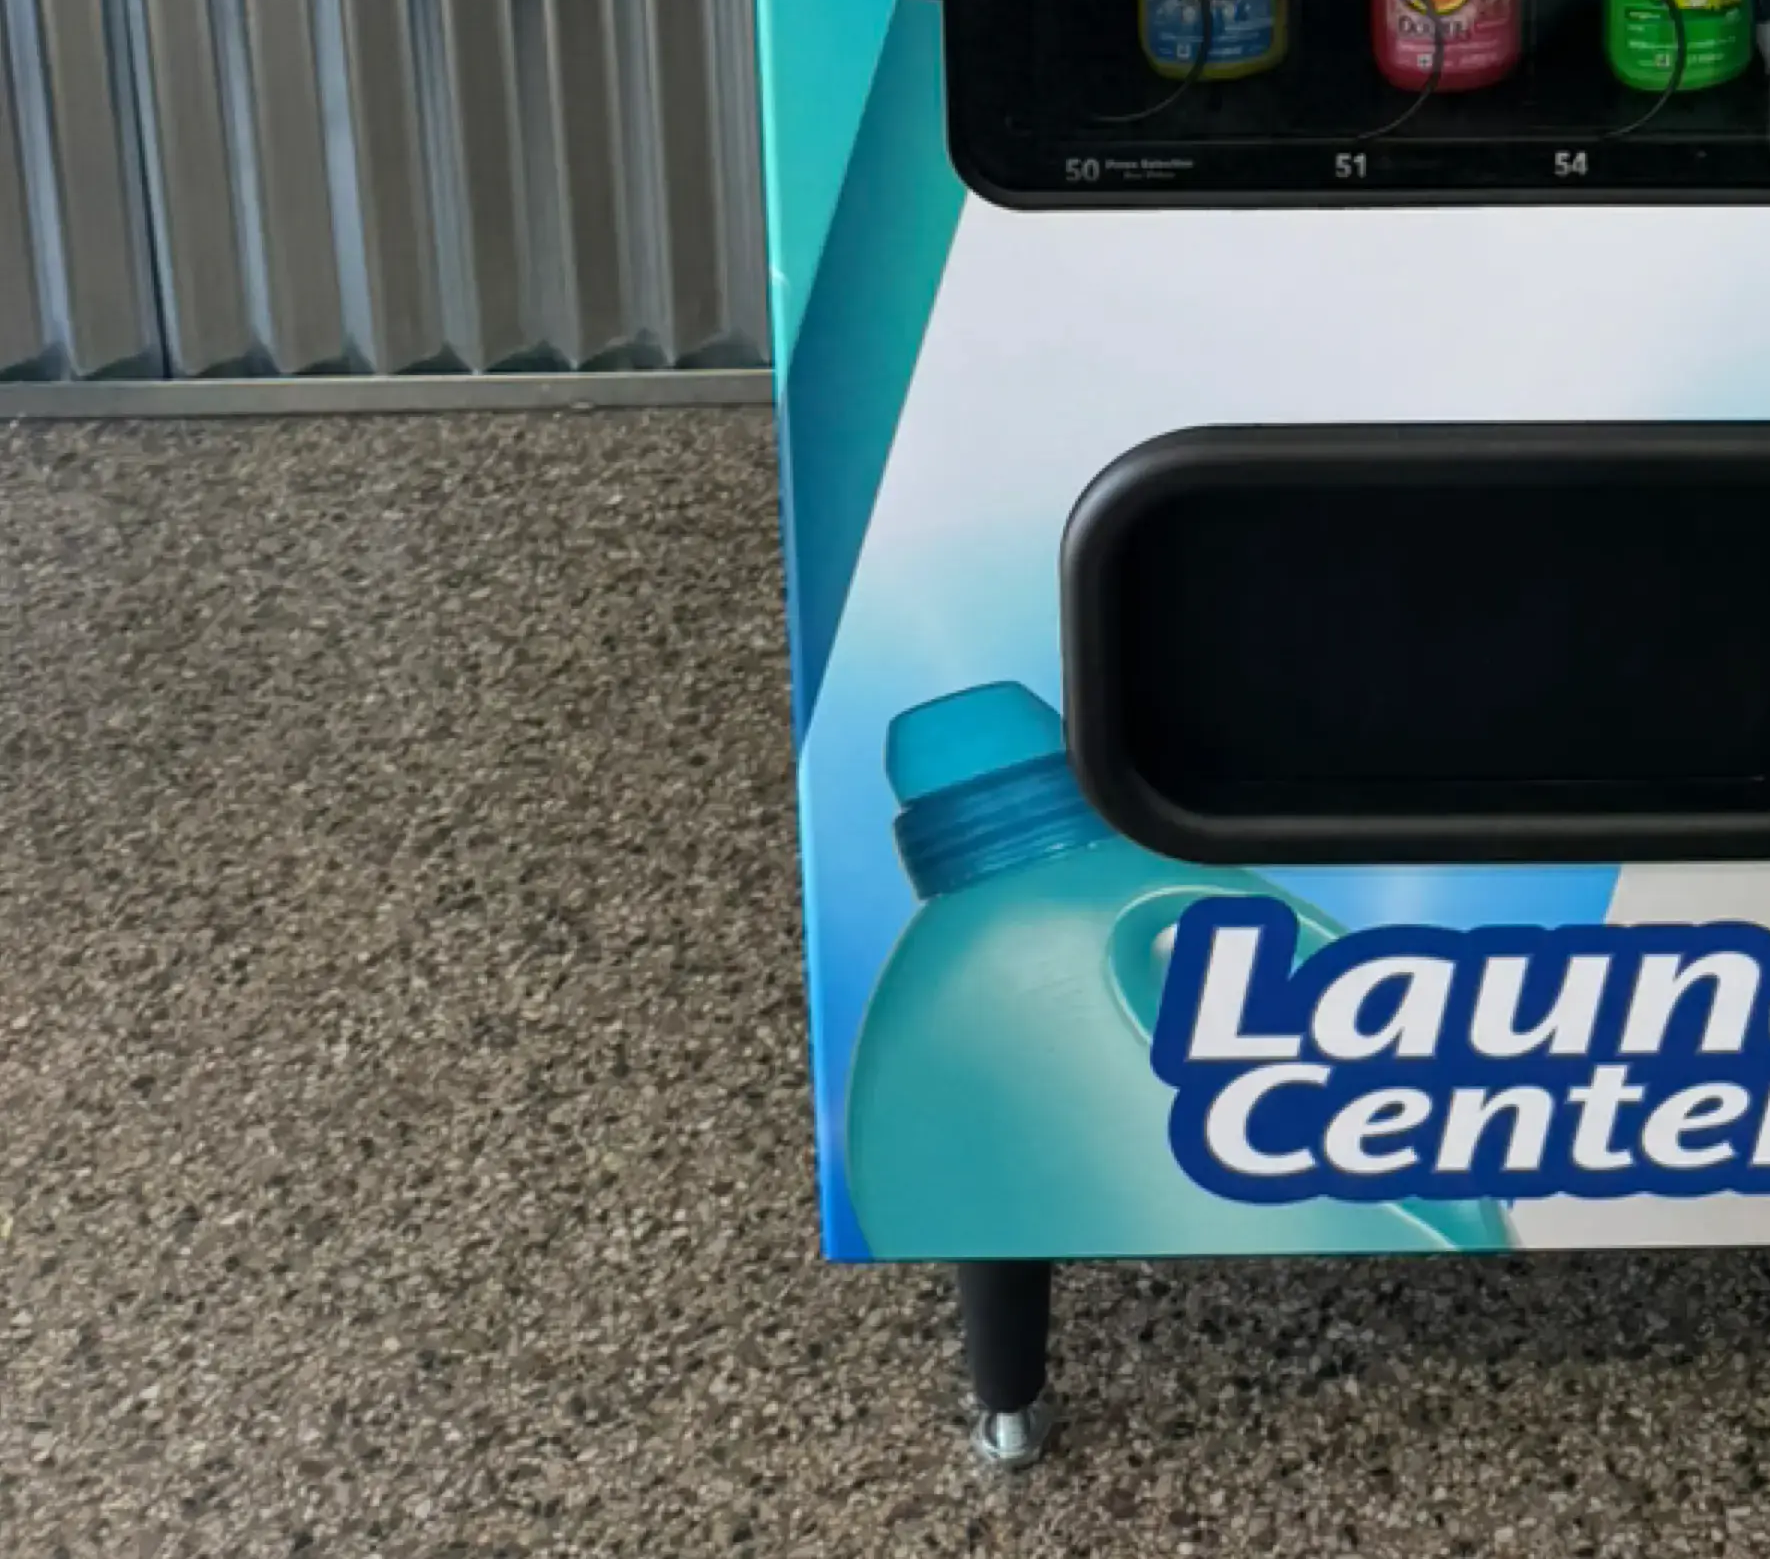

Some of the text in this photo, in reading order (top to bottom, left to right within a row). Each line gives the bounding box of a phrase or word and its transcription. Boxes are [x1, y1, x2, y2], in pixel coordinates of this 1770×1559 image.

[1065, 158, 1100, 181] 50
[1335, 152, 1367, 178] 51
[1554, 151, 1588, 177] 54
